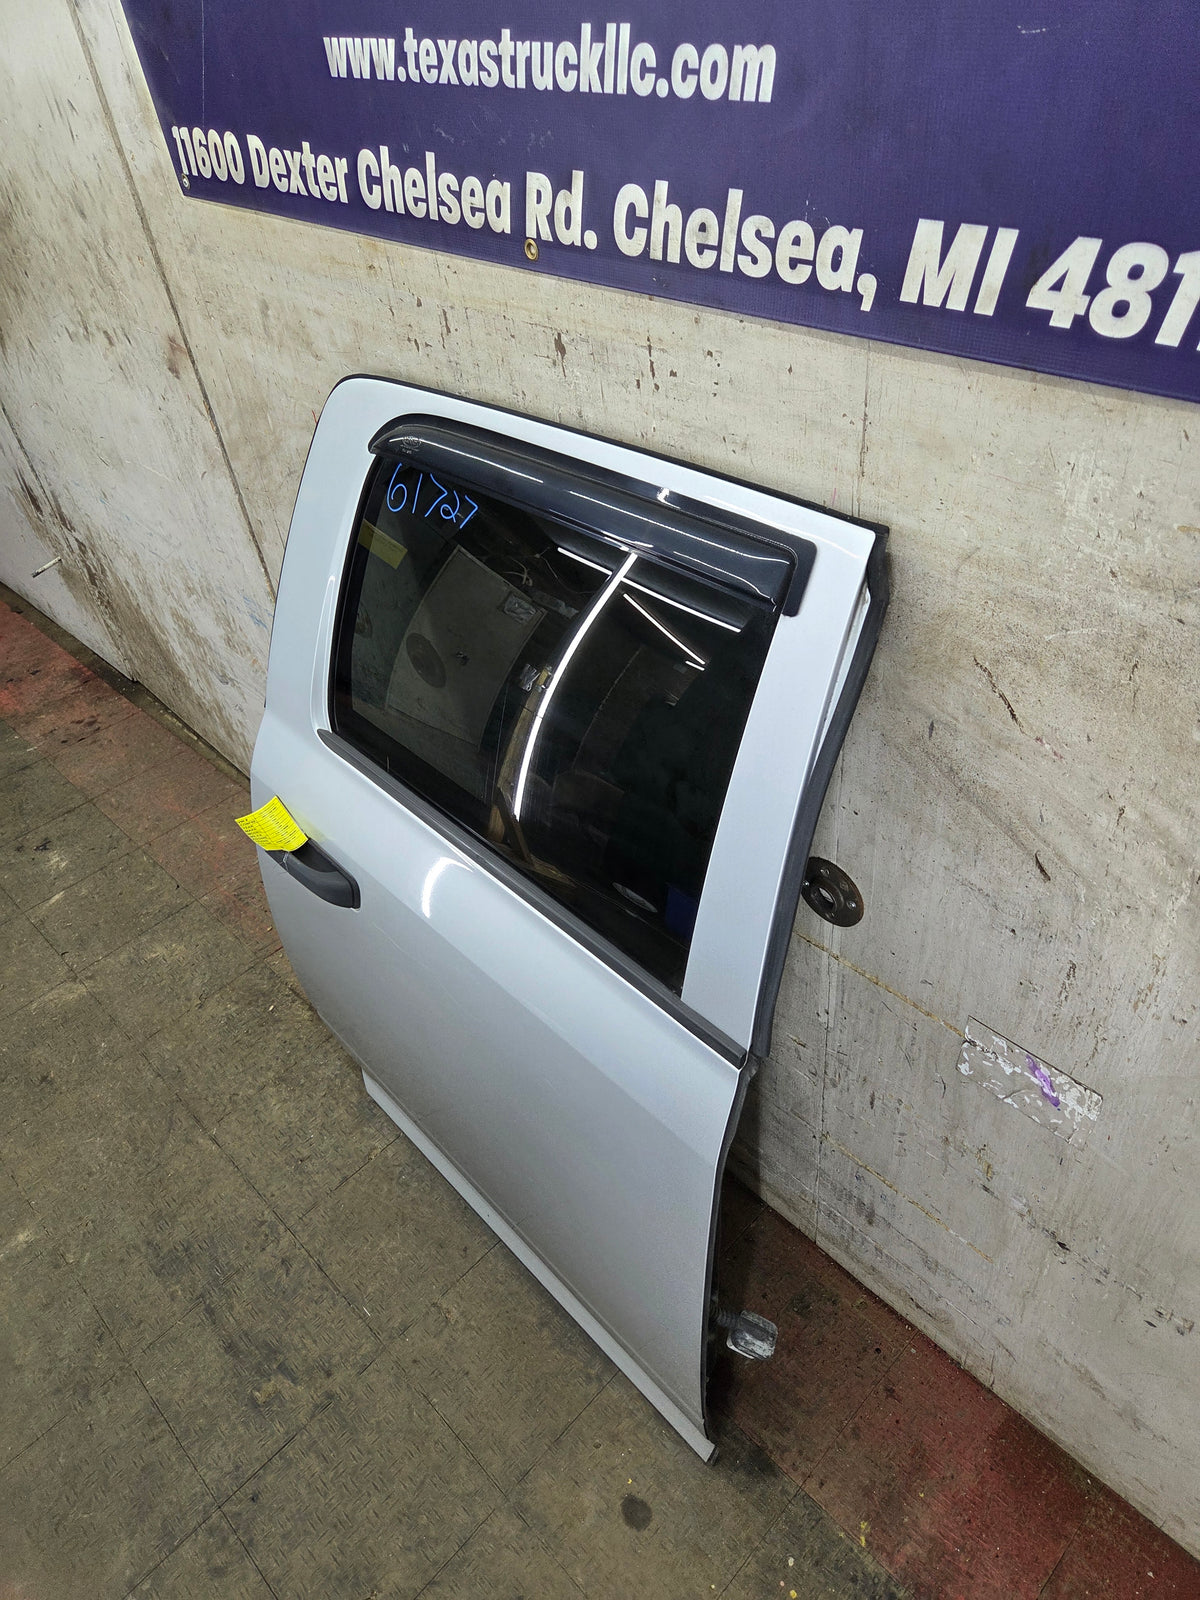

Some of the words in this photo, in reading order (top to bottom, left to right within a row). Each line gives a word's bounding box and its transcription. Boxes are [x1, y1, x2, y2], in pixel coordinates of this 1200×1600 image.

[322, 22, 777, 104] www.texastruckllc.com
[171, 125, 245, 185] 11600
[246, 134, 348, 204] Dexter
[357, 145, 511, 235] Chelsea
[525, 170, 598, 250] Rd.
[613, 179, 878, 313] Chelsea,
[899, 218, 1020, 317] MI
[1025, 235, 1200, 351] 481
[386, 462, 479, 529] 61727
